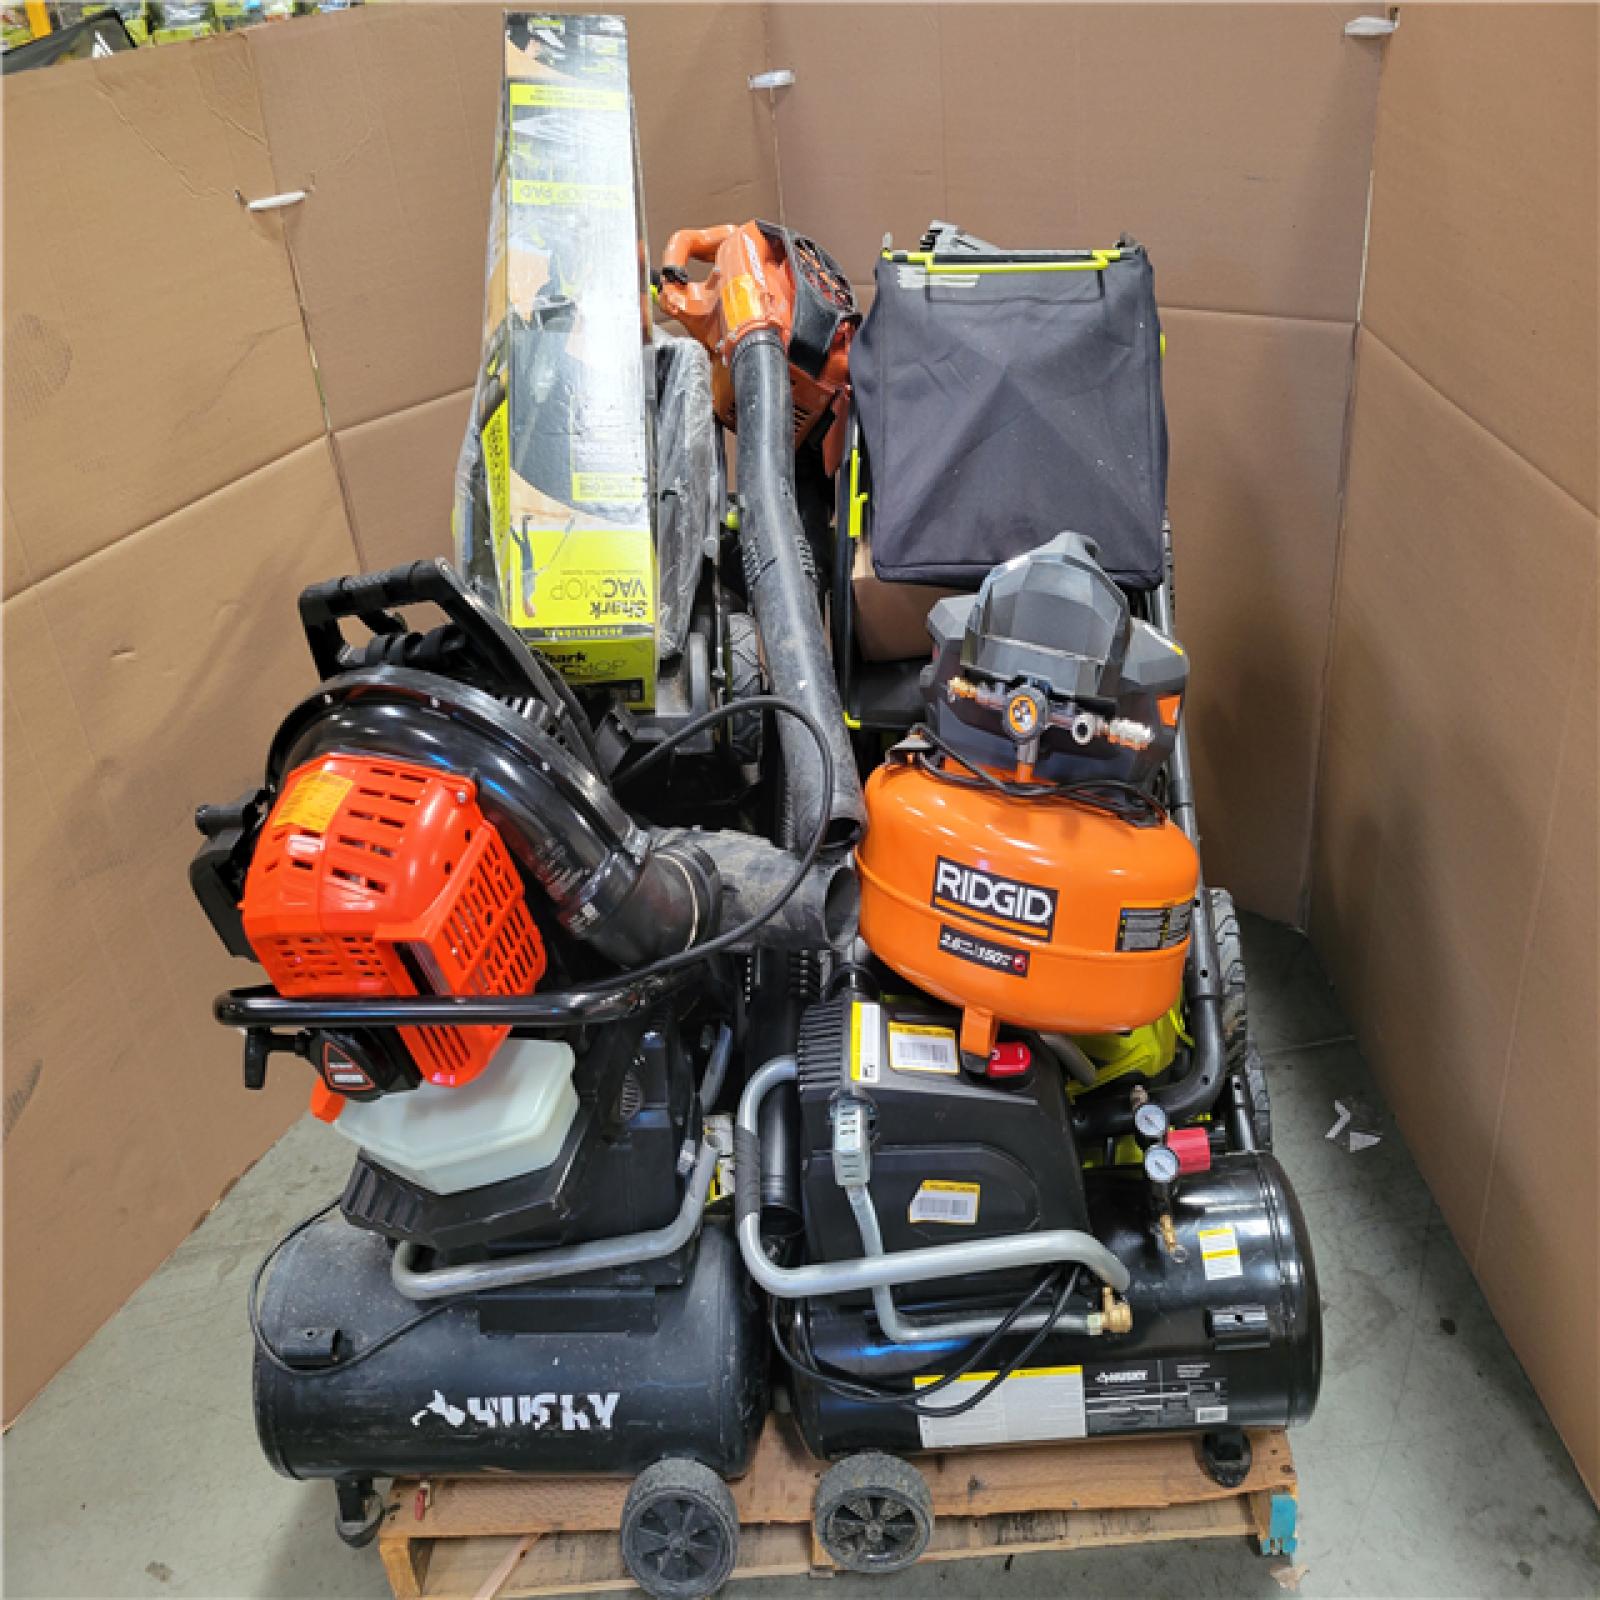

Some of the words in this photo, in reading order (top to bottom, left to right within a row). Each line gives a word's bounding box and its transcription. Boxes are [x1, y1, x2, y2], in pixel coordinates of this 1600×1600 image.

[550, 577, 647, 600] VACMOP
[590, 600, 648, 620] Shark
[936, 860, 1053, 925] RIDGID
